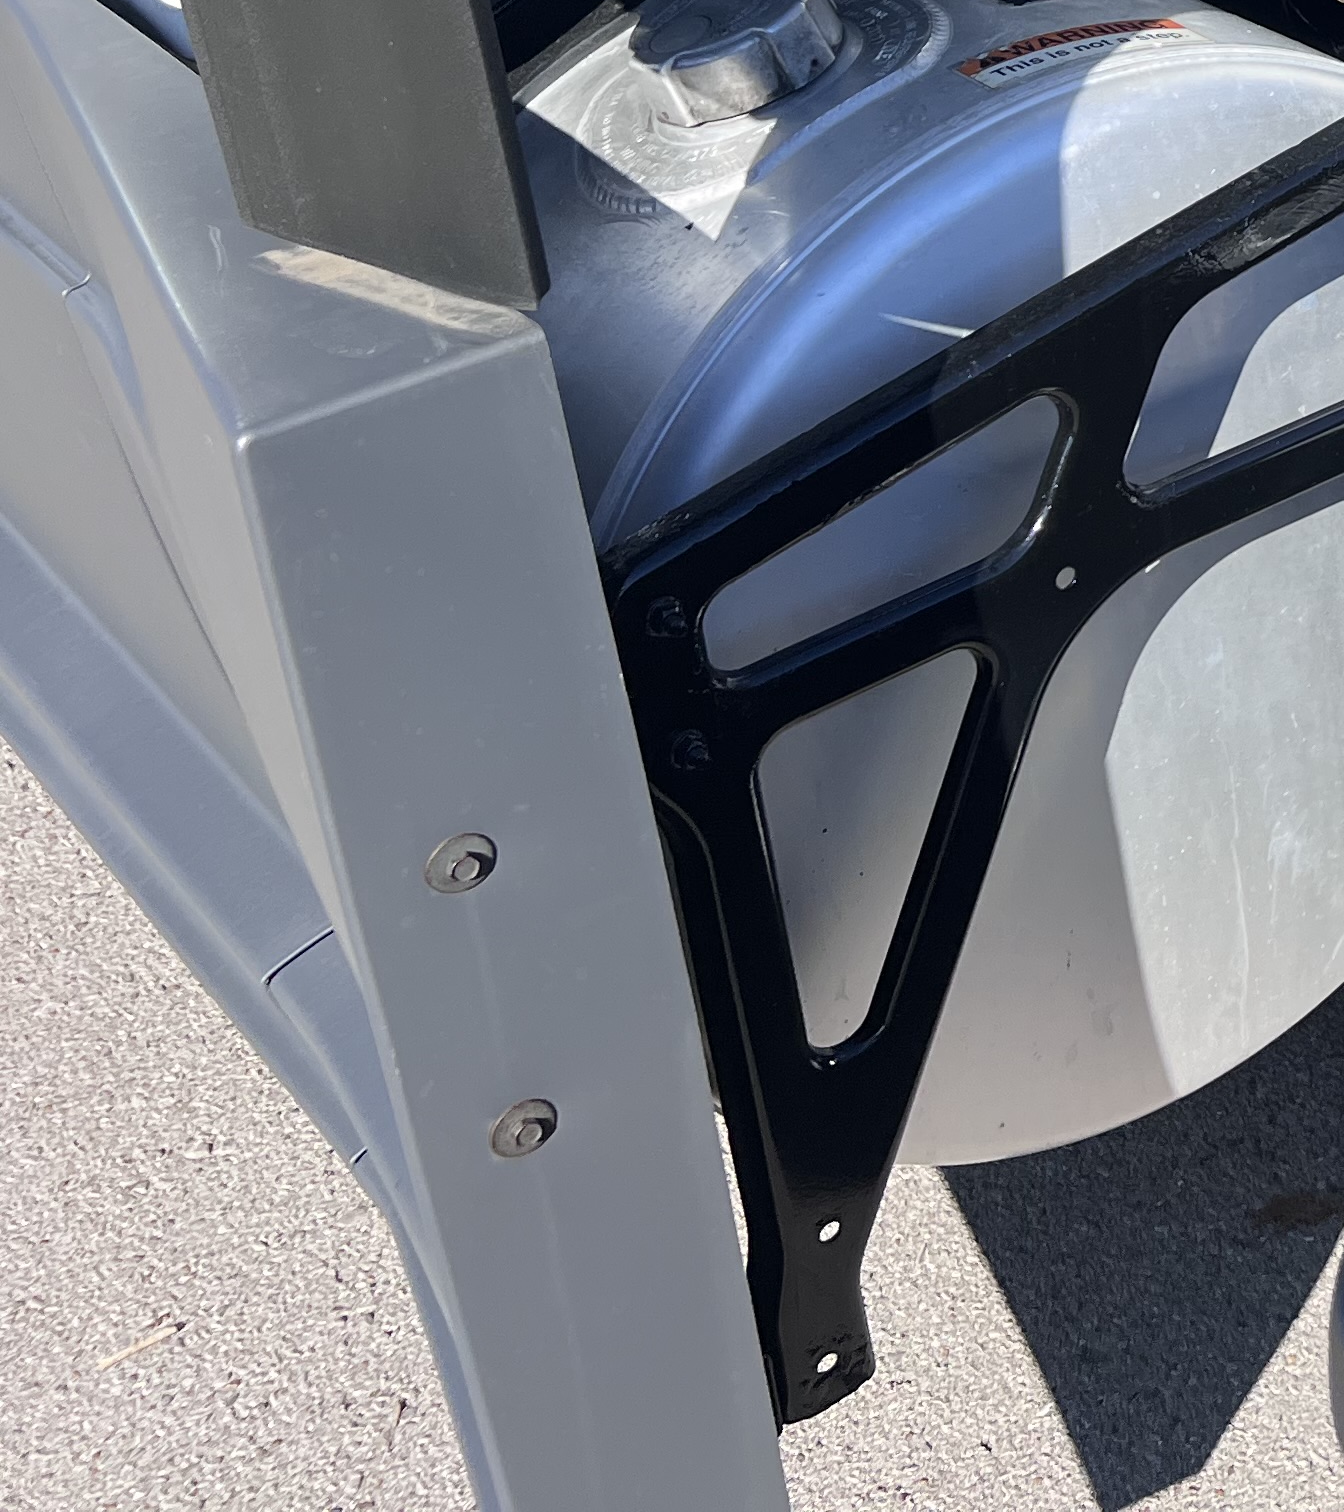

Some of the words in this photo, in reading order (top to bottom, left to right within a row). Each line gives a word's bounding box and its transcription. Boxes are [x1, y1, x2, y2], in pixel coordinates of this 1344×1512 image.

[1005, 20, 1168, 57] WARNING
[989, 56, 1044, 78] This
[1046, 46, 1070, 60] is
[1074, 39, 1114, 53] not
